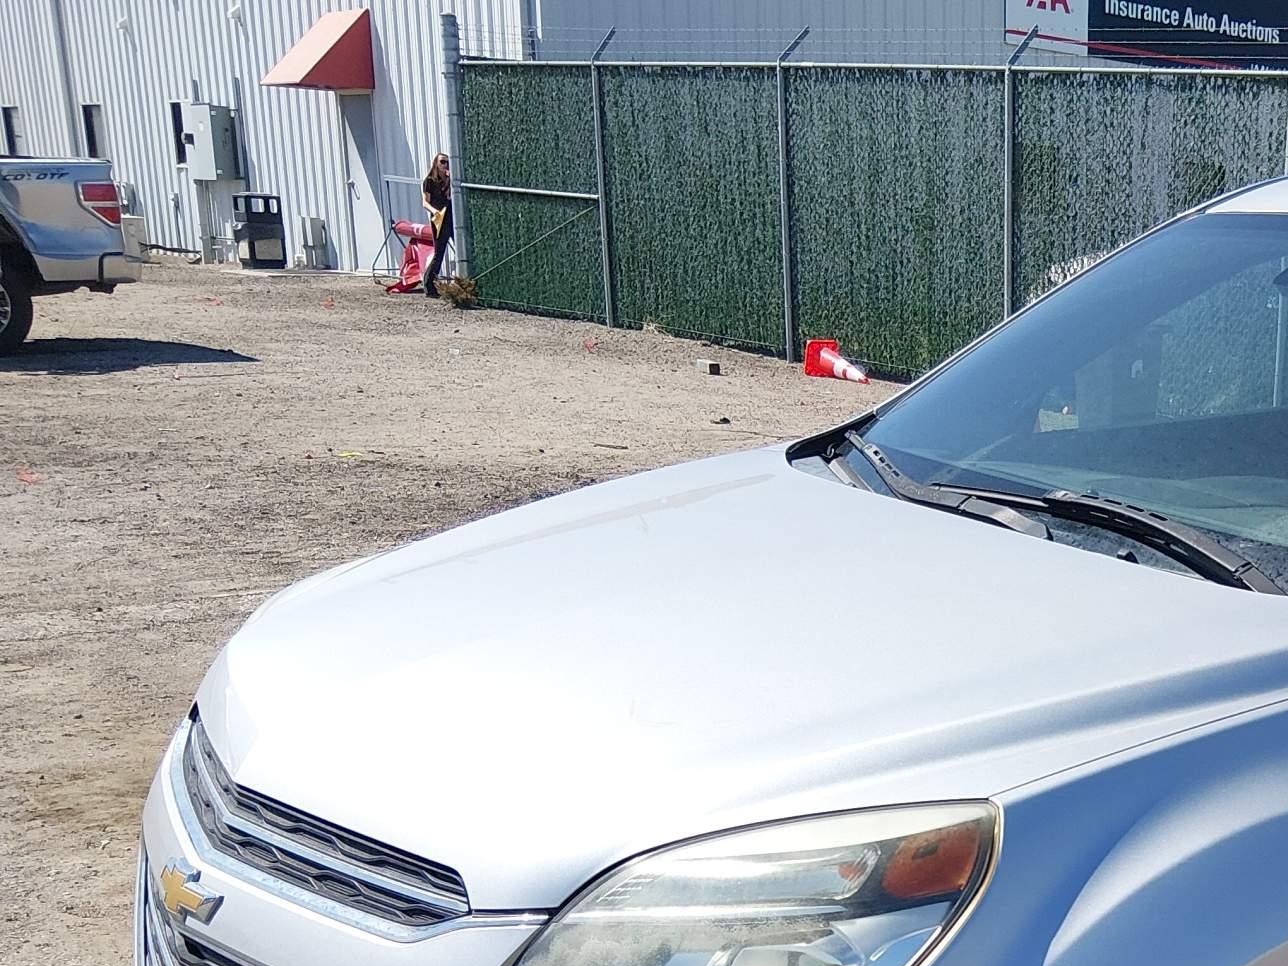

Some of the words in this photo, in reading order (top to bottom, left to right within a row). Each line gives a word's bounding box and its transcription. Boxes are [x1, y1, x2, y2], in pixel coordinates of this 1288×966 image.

[1105, 0, 1179, 25] Insurance
[1183, 7, 1216, 32] Auto
[1219, 14, 1280, 43] Auctions
